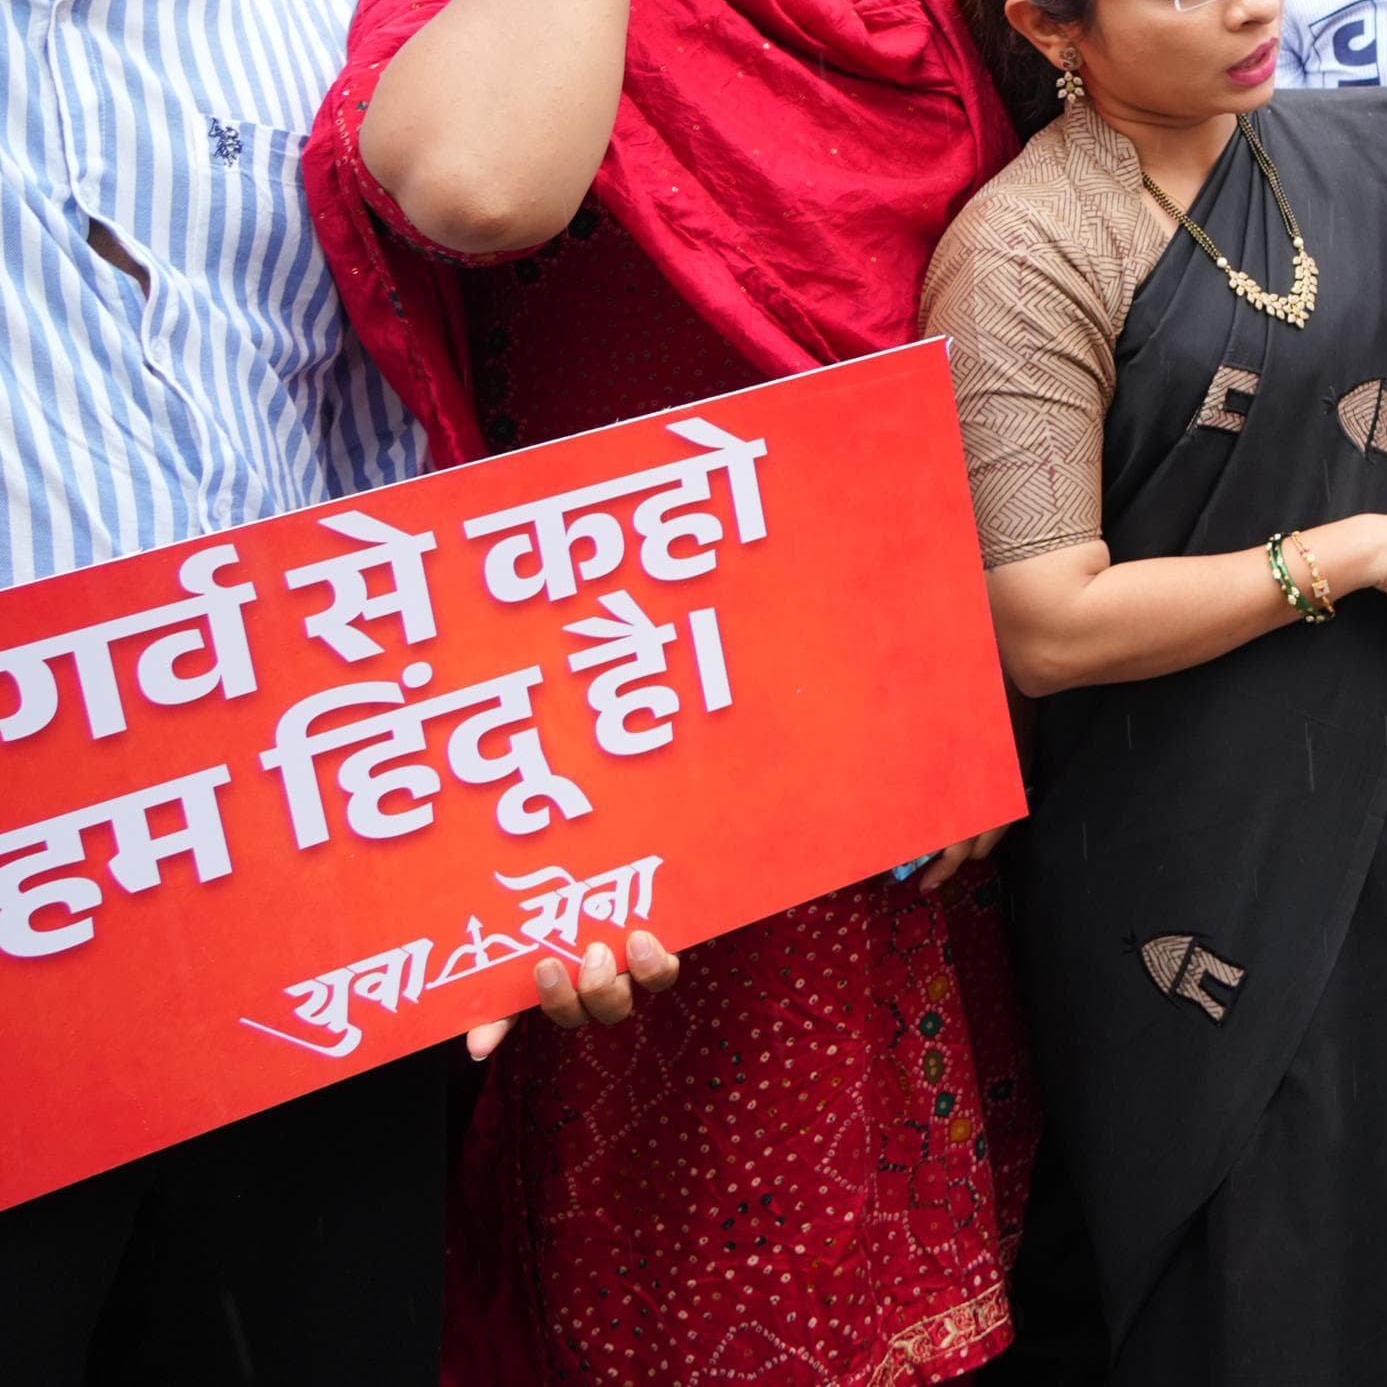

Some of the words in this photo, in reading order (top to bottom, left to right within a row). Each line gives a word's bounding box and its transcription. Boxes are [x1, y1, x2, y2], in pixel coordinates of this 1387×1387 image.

[0, 545, 258, 743] गर्व
[285, 510, 437, 663] से
[464, 417, 767, 604] कहो
[0, 764, 234, 959] हम
[260, 660, 593, 852] हिंदू
[561, 589, 732, 757] है।
